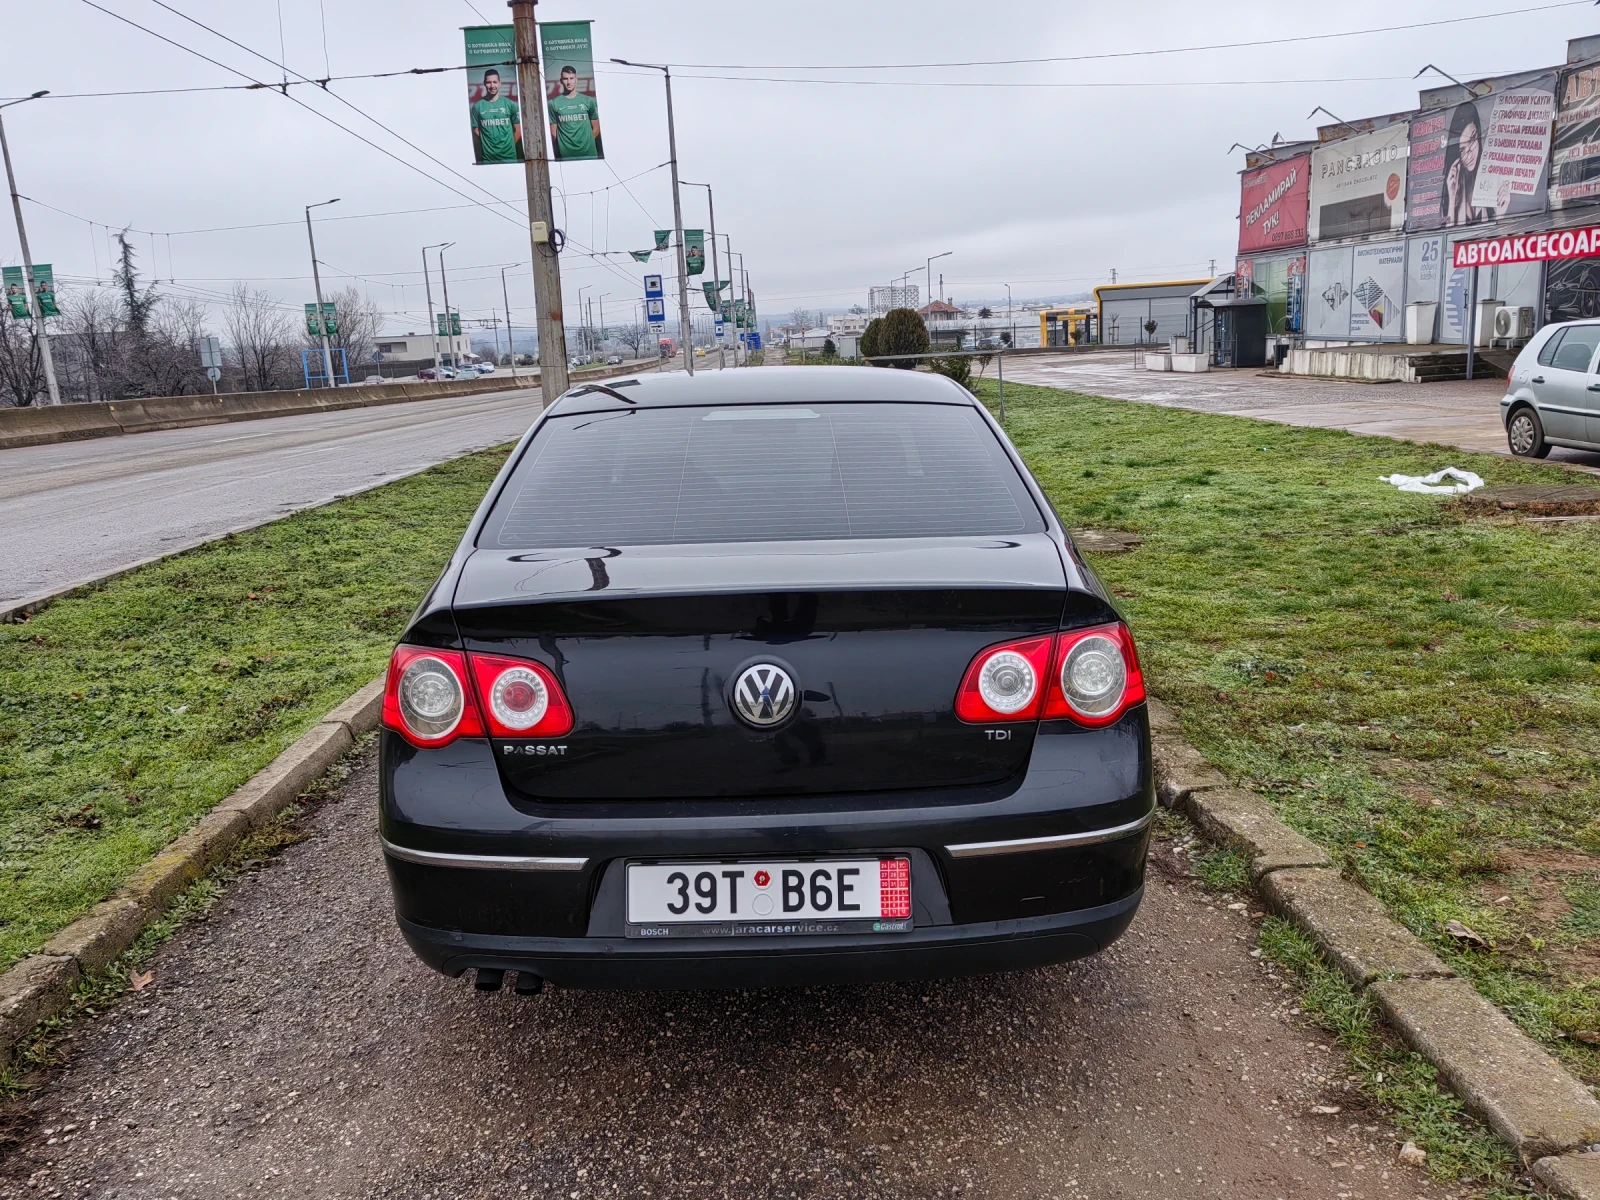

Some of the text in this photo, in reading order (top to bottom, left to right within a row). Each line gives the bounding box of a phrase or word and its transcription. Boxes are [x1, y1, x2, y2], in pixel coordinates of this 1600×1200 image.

[480, 118, 509, 127] WINBET
[558, 114, 588, 122] WINBET
[1521, 125, 1546, 135] РЕКЛАМА
[1517, 140, 1542, 150] РЕКЛАМА
[1322, 144, 1398, 179] PANCRACIO
[1516, 154, 1542, 165] СУВЕНИРИ
[1246, 167, 1297, 228] РЕКЛАМИРАЙ
[1263, 210, 1279, 235] ТУК!
[1422, 240, 1438, 262] 25
[1456, 229, 1600, 265] АВТОАКСЕСОАР
[1379, 256, 1403, 265] МАТЕРИАЛИ
[984, 730, 1012, 740] TDI
[504, 746, 568, 755] PASSAT
[666, 868, 860, 915] 39T B6E
[641, 928, 669, 936] BOSCH
[702, 923, 839, 936] www.jaracarservice.cz
